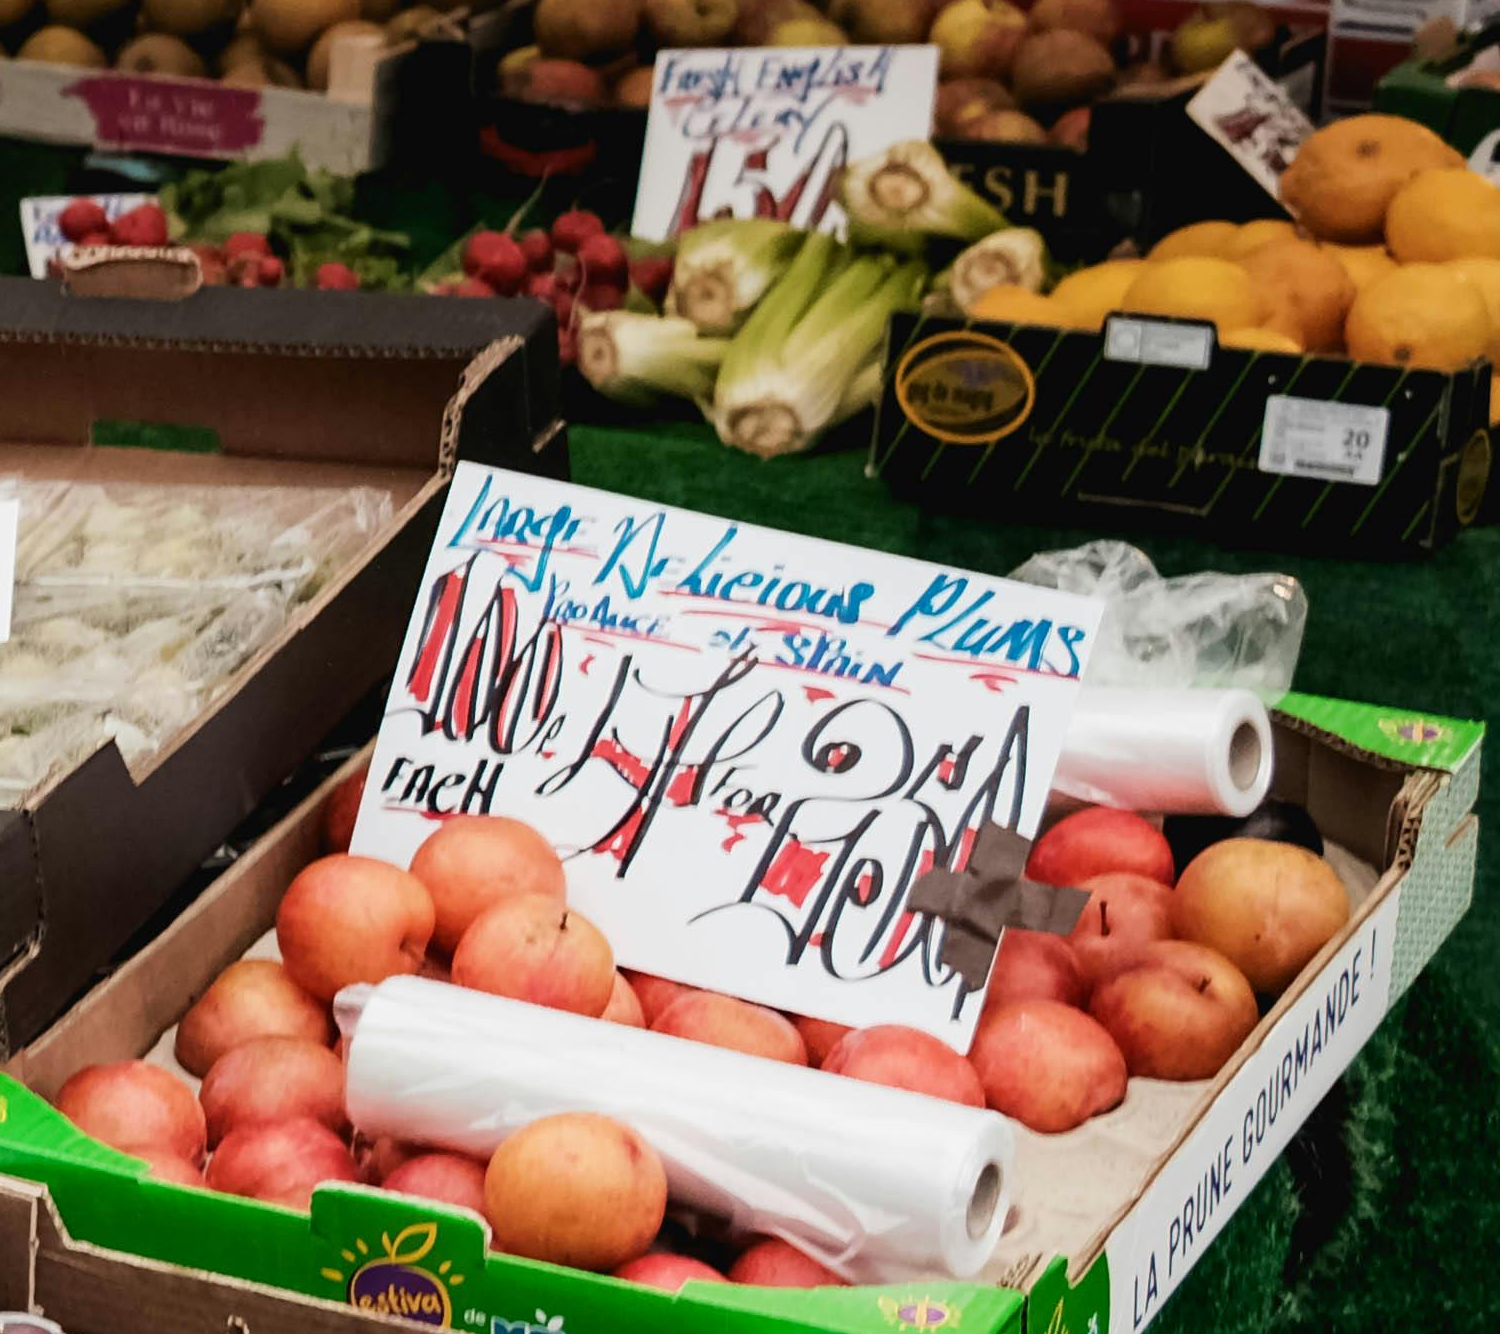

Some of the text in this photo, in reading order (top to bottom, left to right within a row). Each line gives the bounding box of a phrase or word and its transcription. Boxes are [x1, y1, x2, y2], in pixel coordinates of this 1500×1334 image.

[1133, 1251, 1158, 1332] LA
[1168, 1134, 1235, 1267] PRUNE
[1241, 978, 1365, 1167] GOURMANDE
